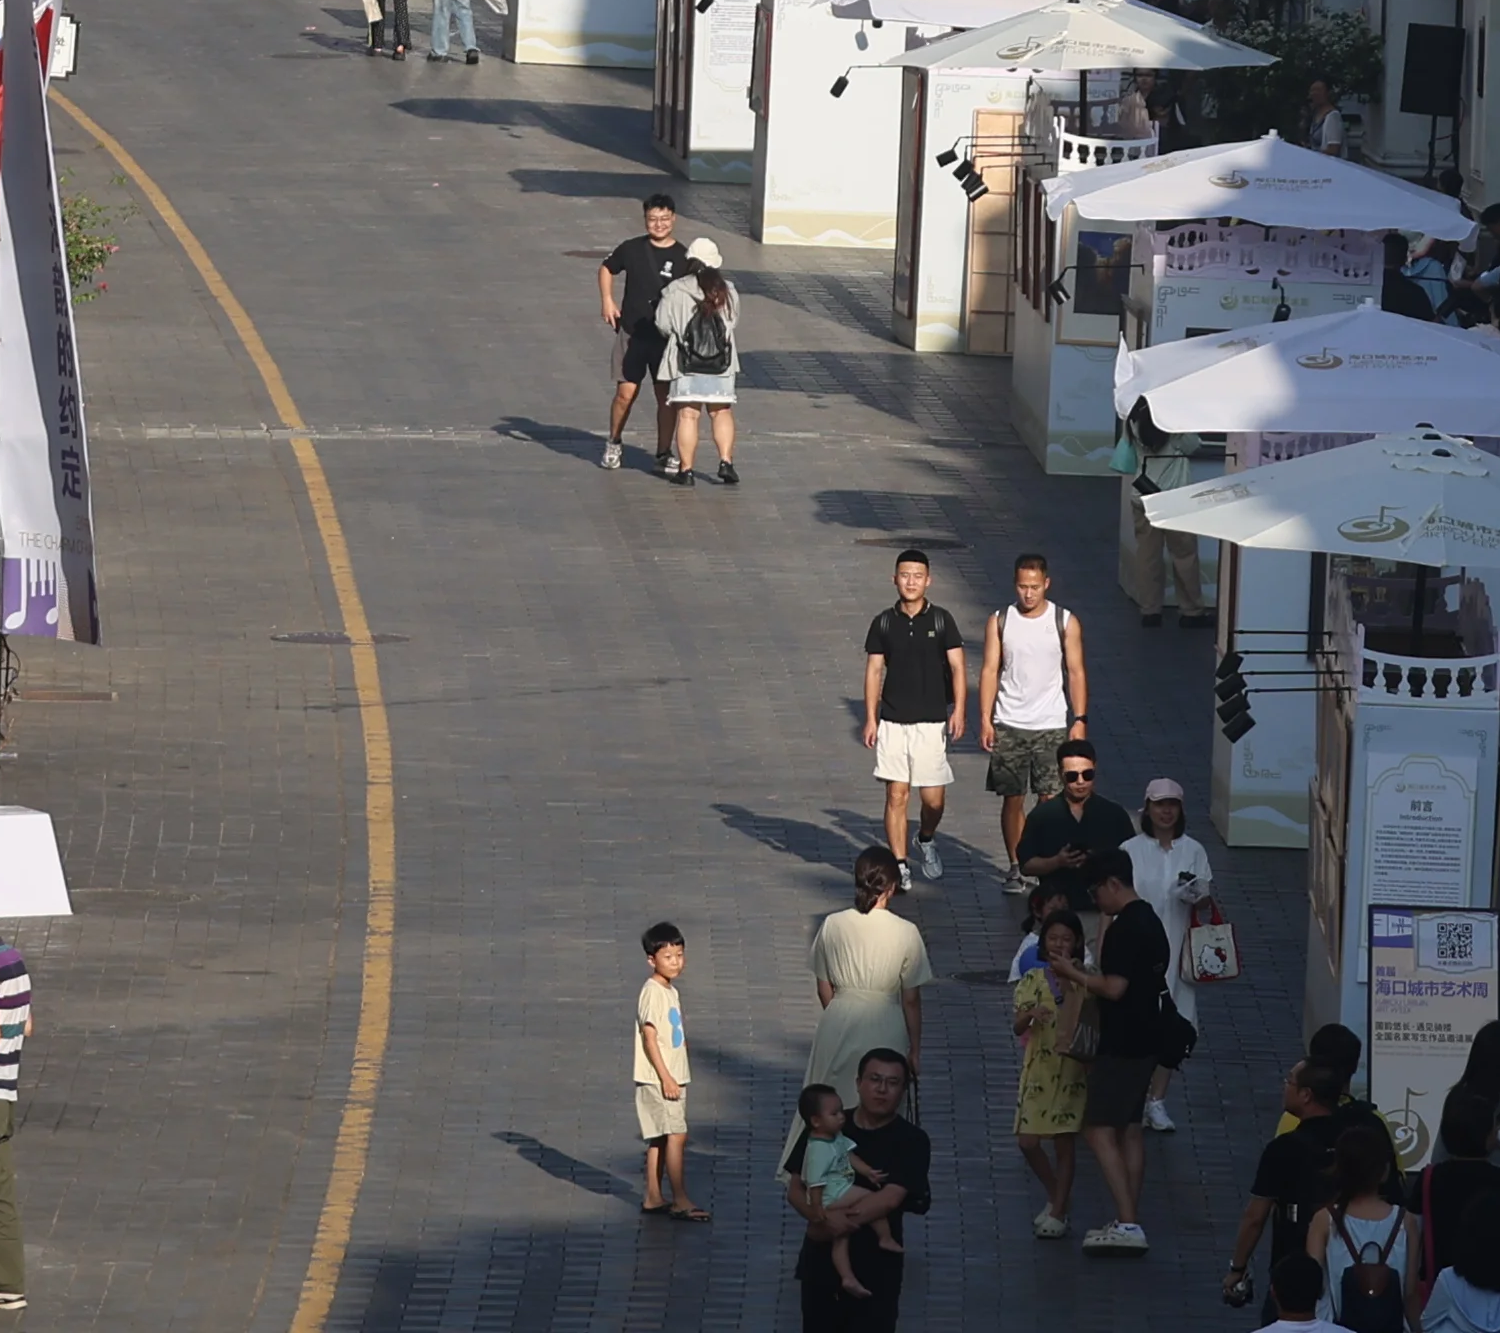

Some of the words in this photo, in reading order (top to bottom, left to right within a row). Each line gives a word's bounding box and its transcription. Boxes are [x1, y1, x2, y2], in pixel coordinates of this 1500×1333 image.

[18, 532, 42, 549] THE
[1399, 813, 1444, 823] Introduction
[1375, 978, 1489, 999] 海口城市艺术周
